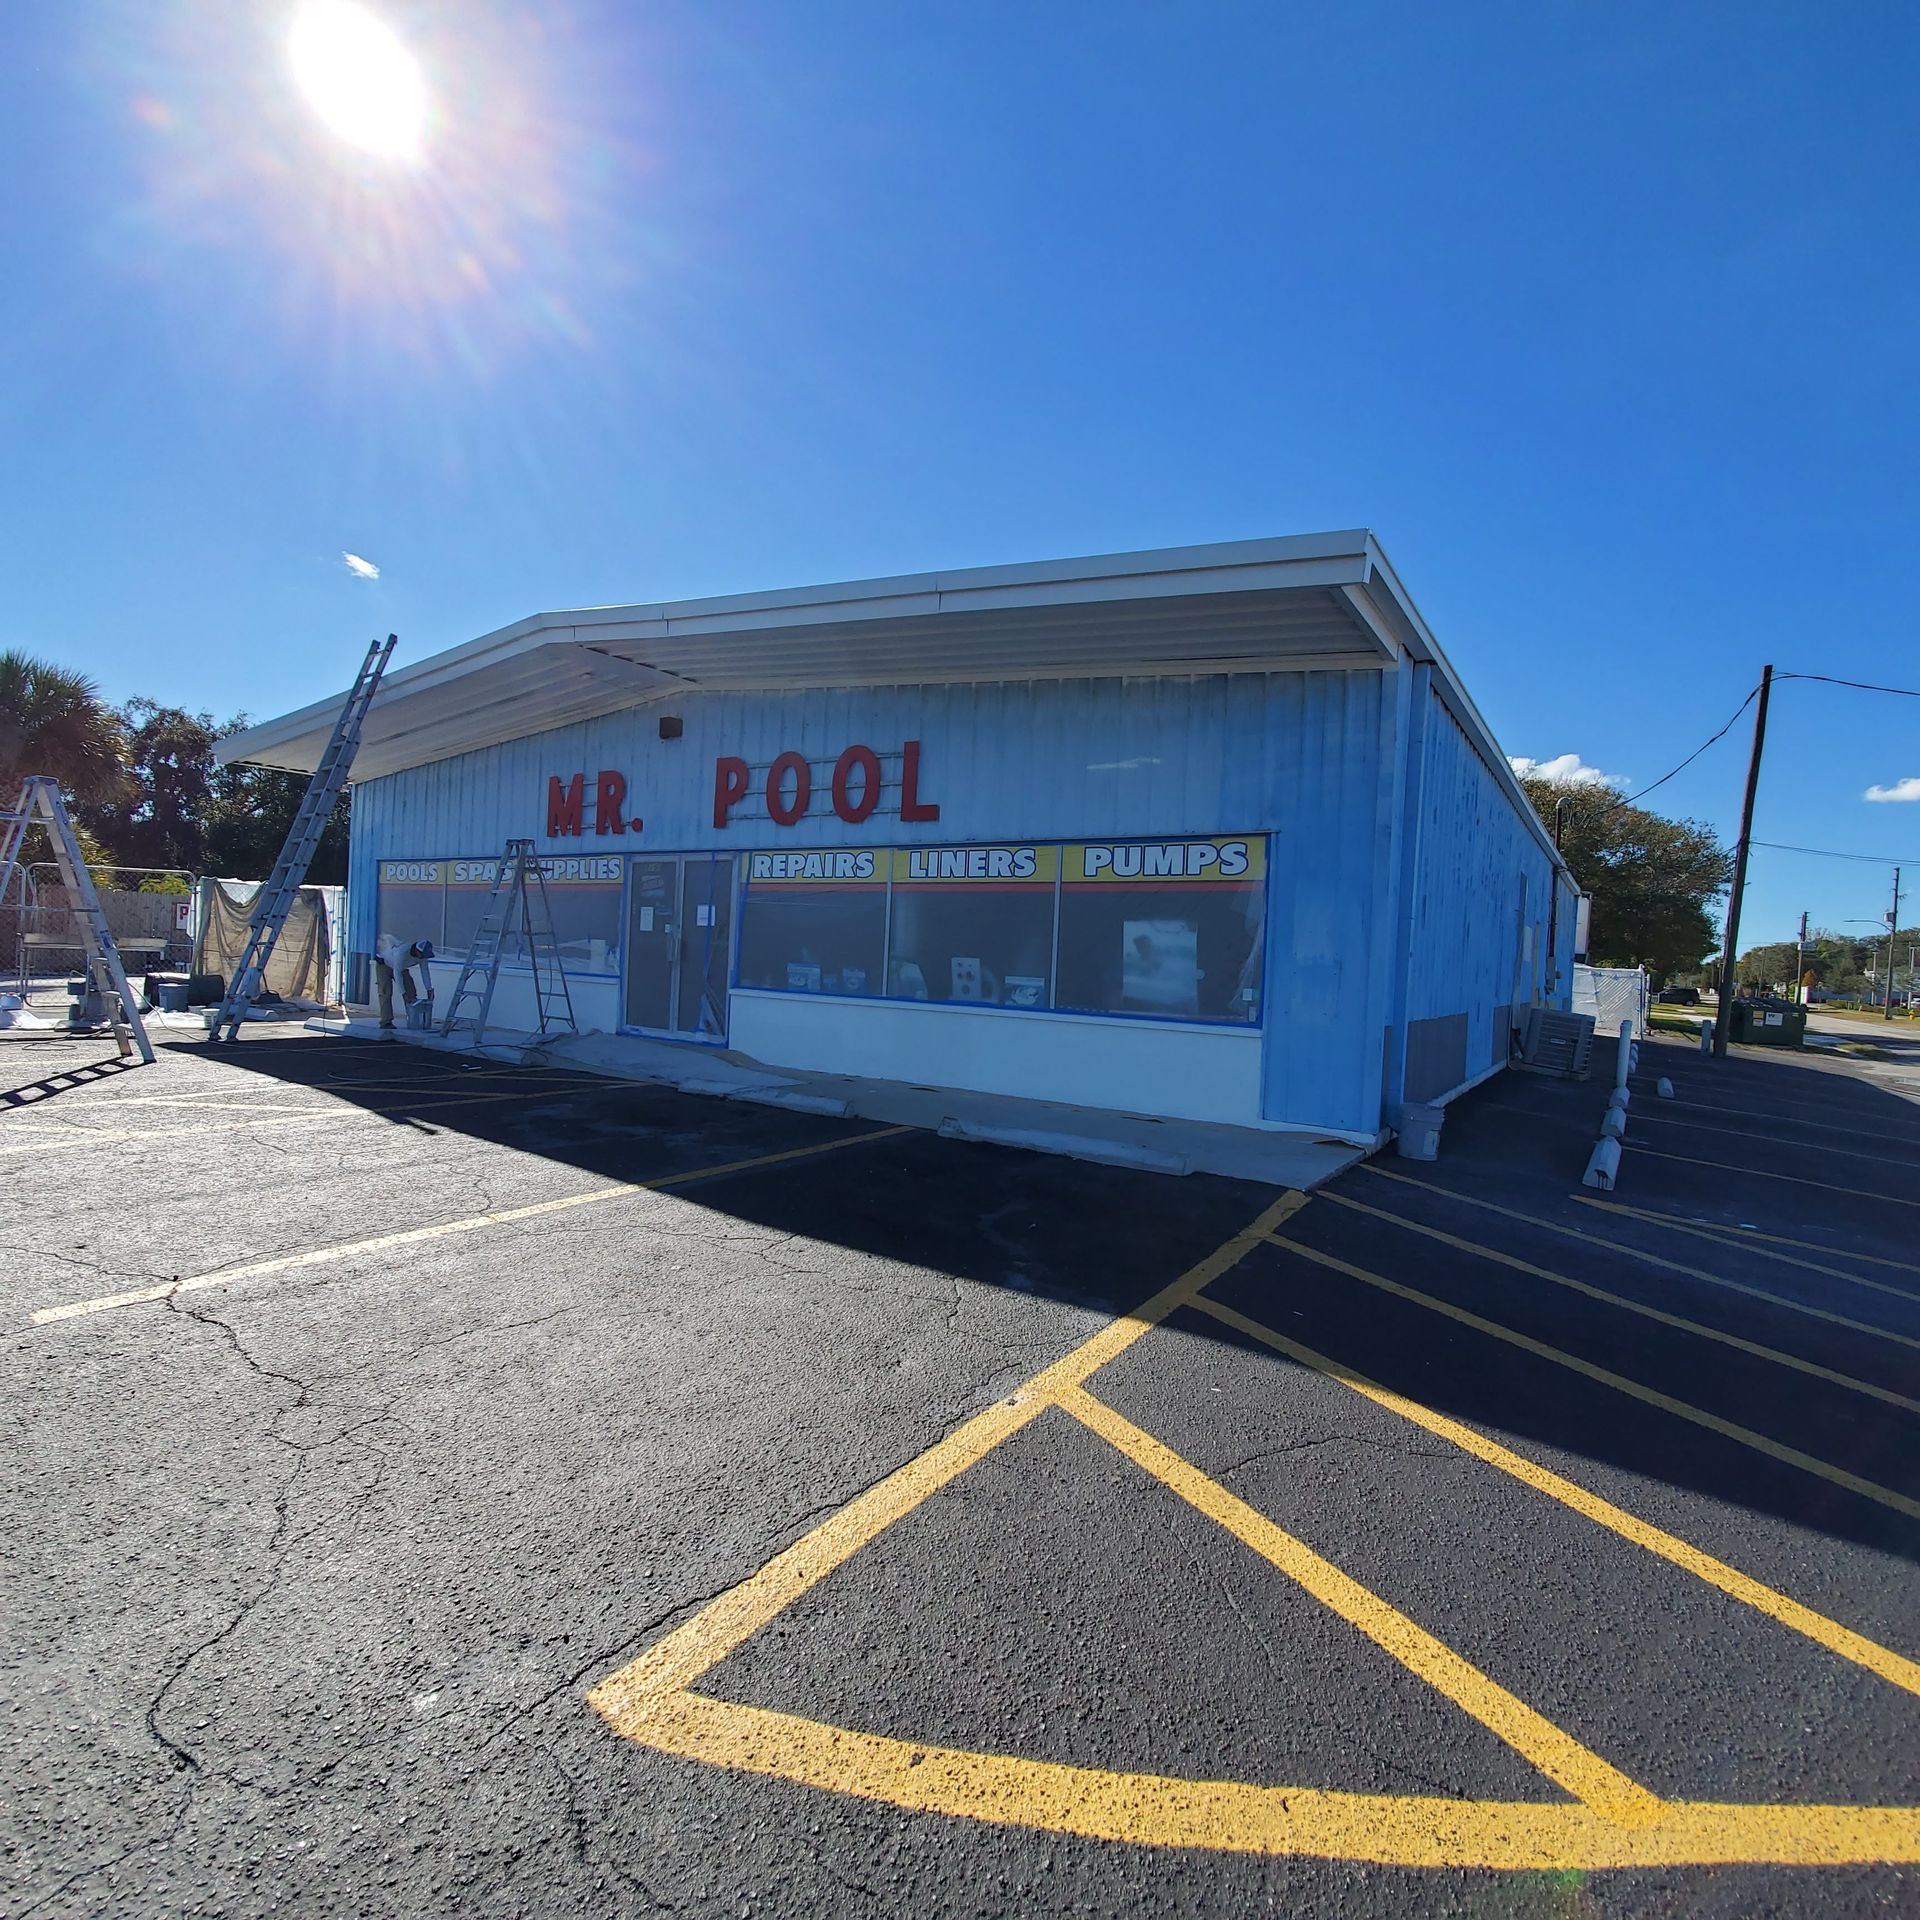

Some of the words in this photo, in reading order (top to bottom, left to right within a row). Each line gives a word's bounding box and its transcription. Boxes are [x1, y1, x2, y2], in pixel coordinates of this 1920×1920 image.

[547, 770, 643, 837] MR.
[713, 741, 940, 829] POOL
[386, 863, 438, 881] POOLS
[752, 851, 874, 880] REPAIRS
[909, 848, 1036, 879] LINERS
[1083, 842, 1248, 878] PUMPS
